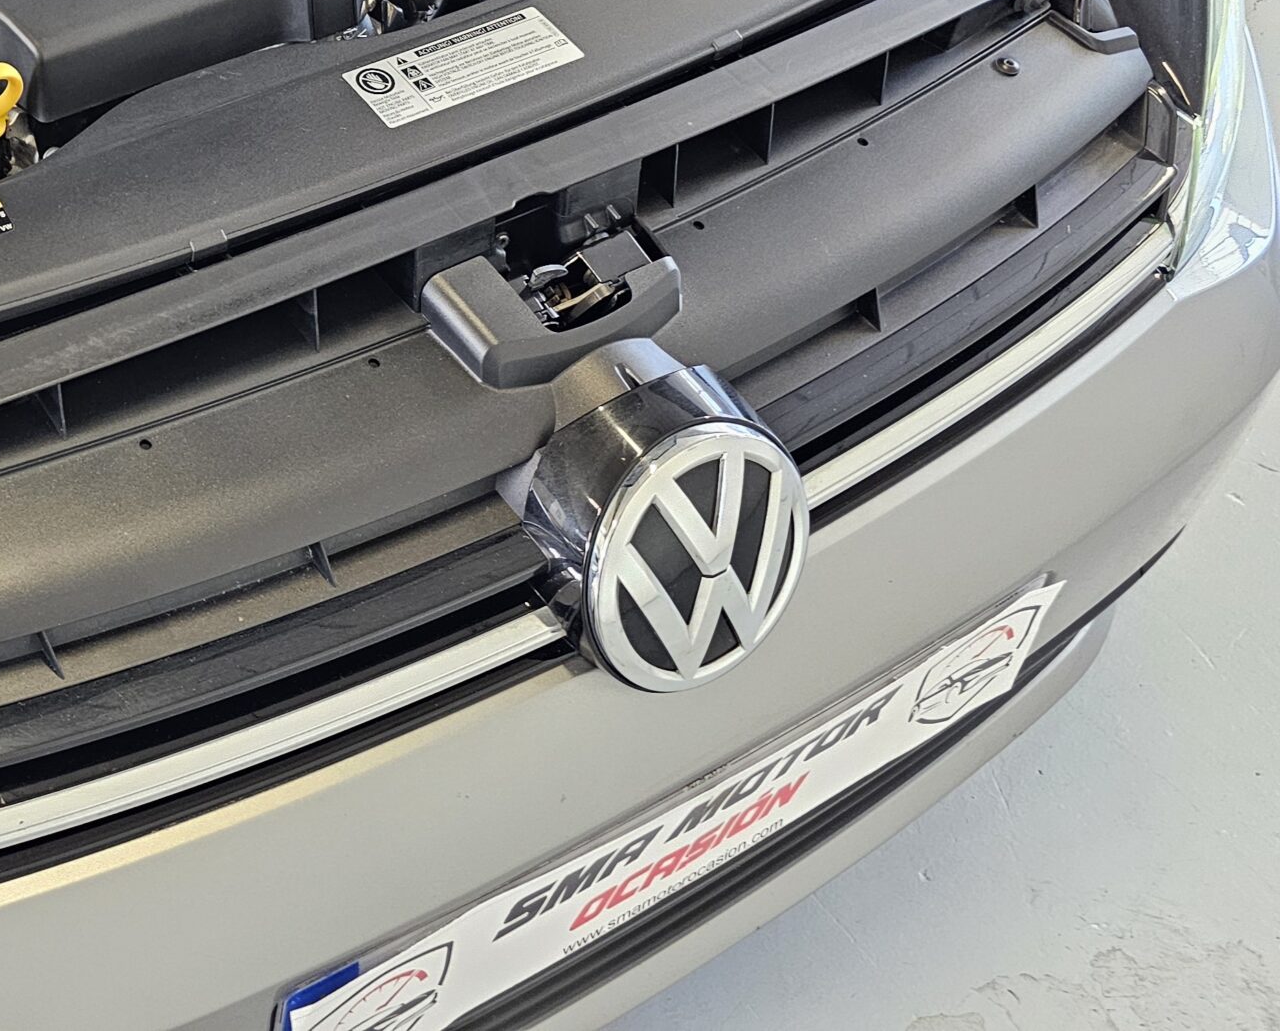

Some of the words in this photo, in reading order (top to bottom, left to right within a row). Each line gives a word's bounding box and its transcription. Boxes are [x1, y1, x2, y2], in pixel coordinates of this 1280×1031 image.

[417, 39, 453, 57] ACHTUNG!
[452, 28, 486, 45] WARNING!
[485, 14, 524, 32] ATTENTION!
[0, 223, 13, 232] VW
[596, 433, 804, 689] VW
[492, 825, 663, 943] SMA
[665, 684, 903, 843] MOTOR
[561, 818, 784, 956] www.smamotorocasion.com
[568, 771, 810, 932] OCASIÓN
